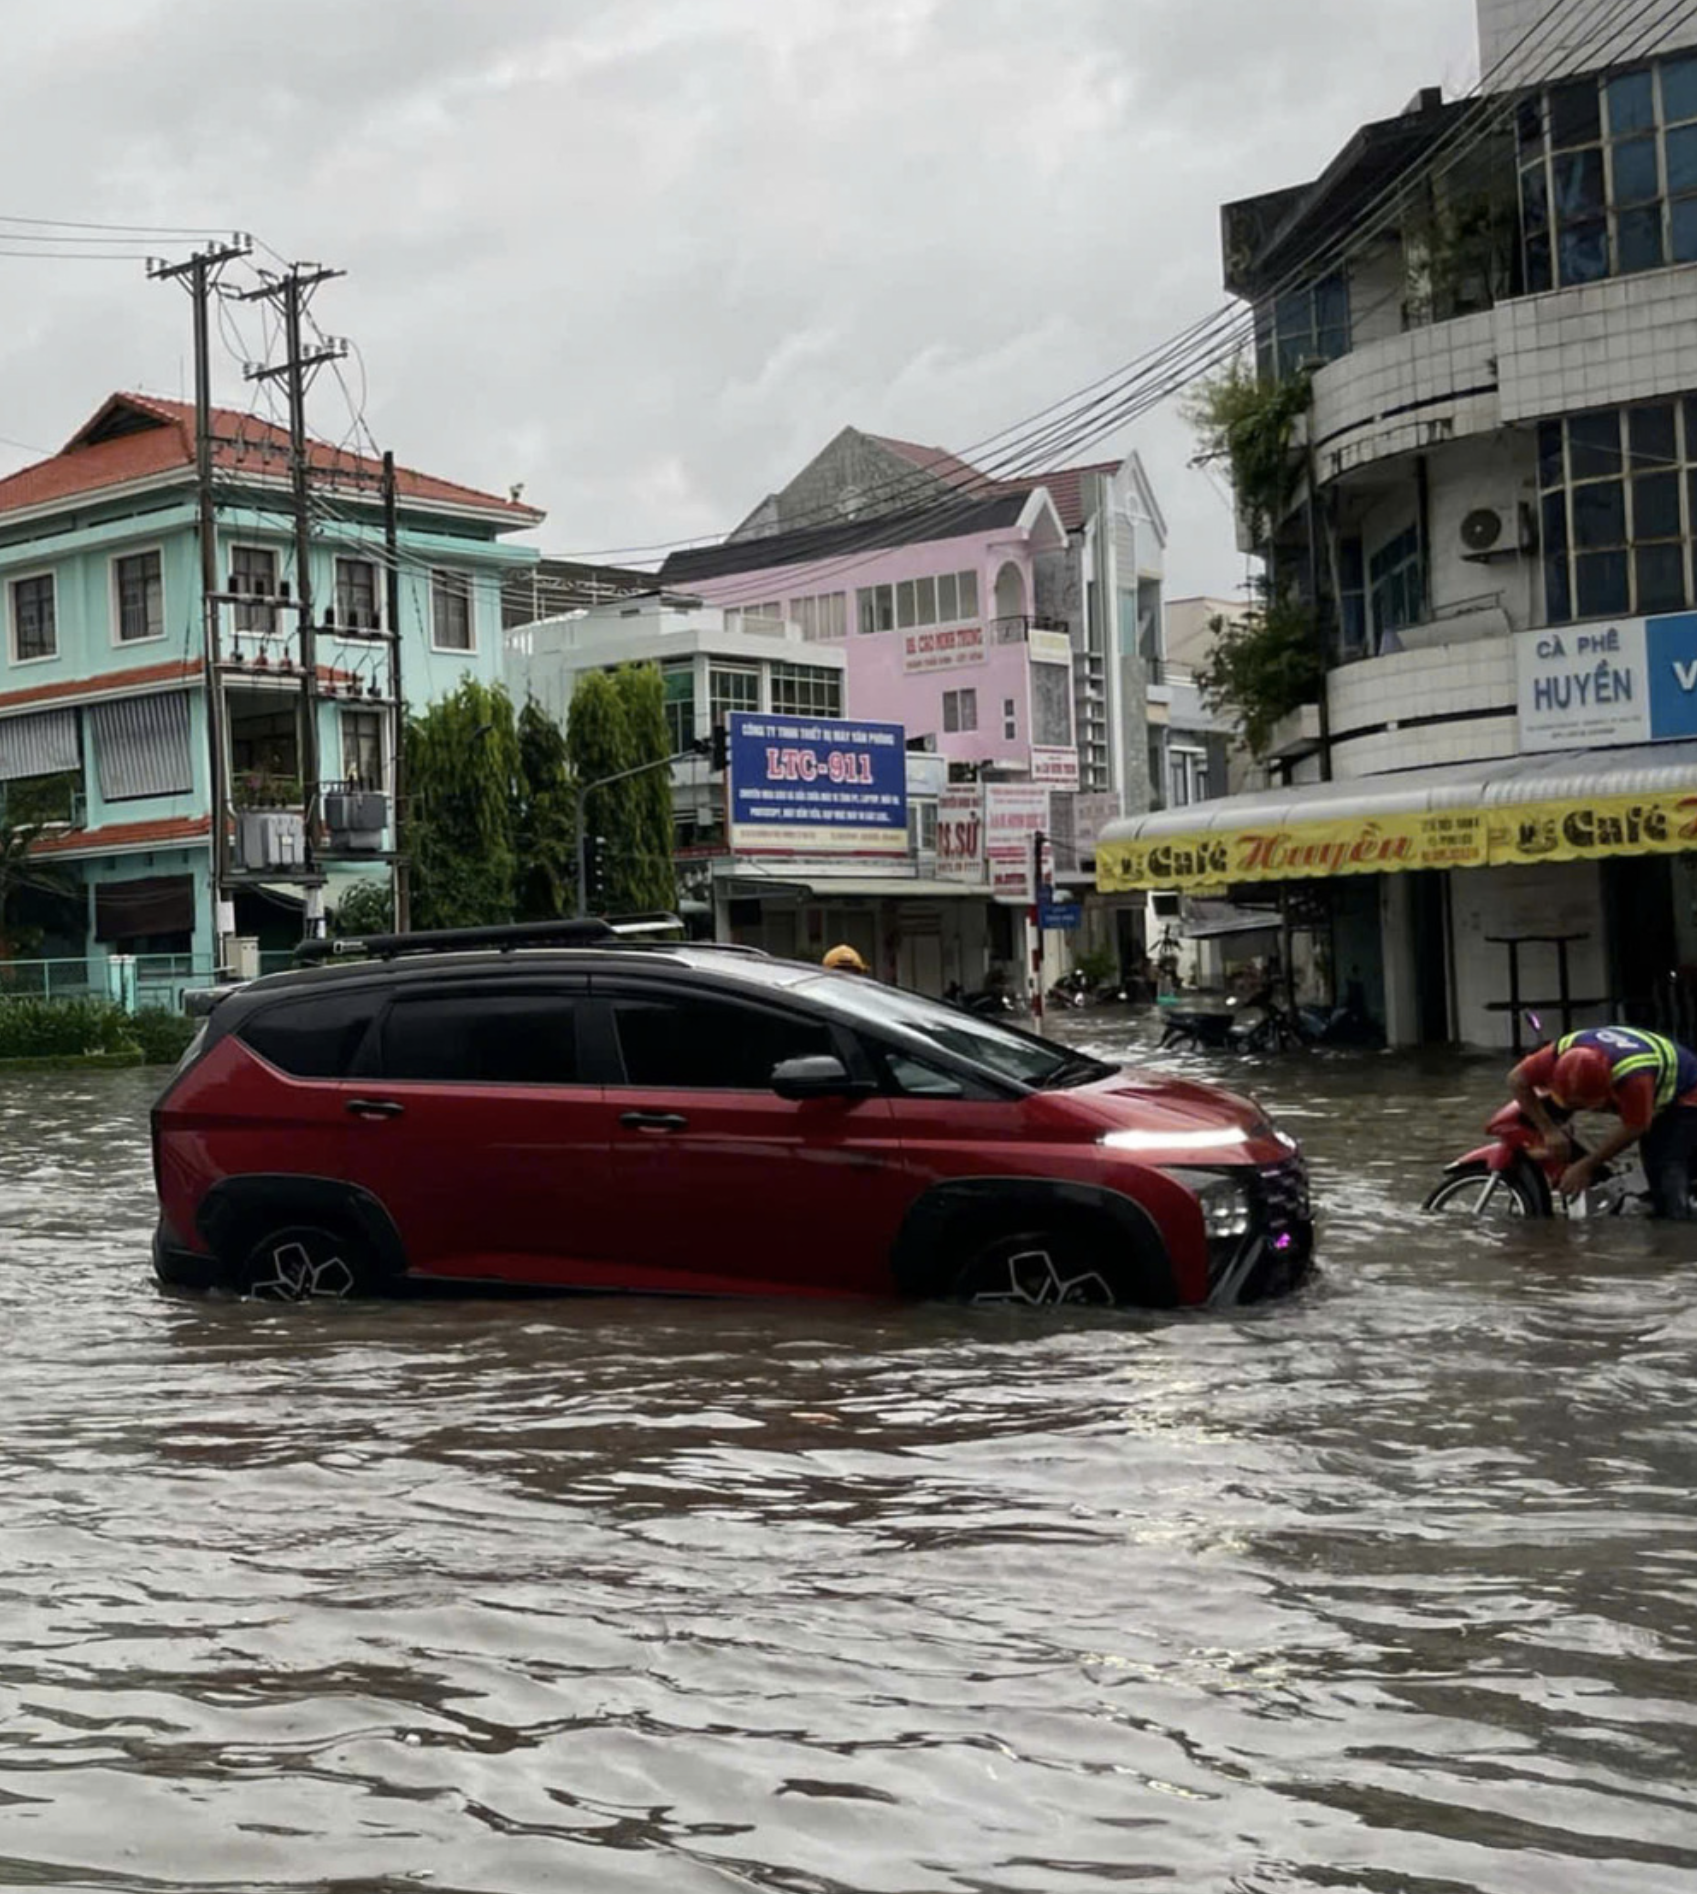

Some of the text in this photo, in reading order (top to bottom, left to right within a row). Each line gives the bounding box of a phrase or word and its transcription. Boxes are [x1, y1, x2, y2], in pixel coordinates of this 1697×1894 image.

[1536, 627, 1620, 659] CÀ PHÊ
[765, 747, 874, 784] LTC-911
